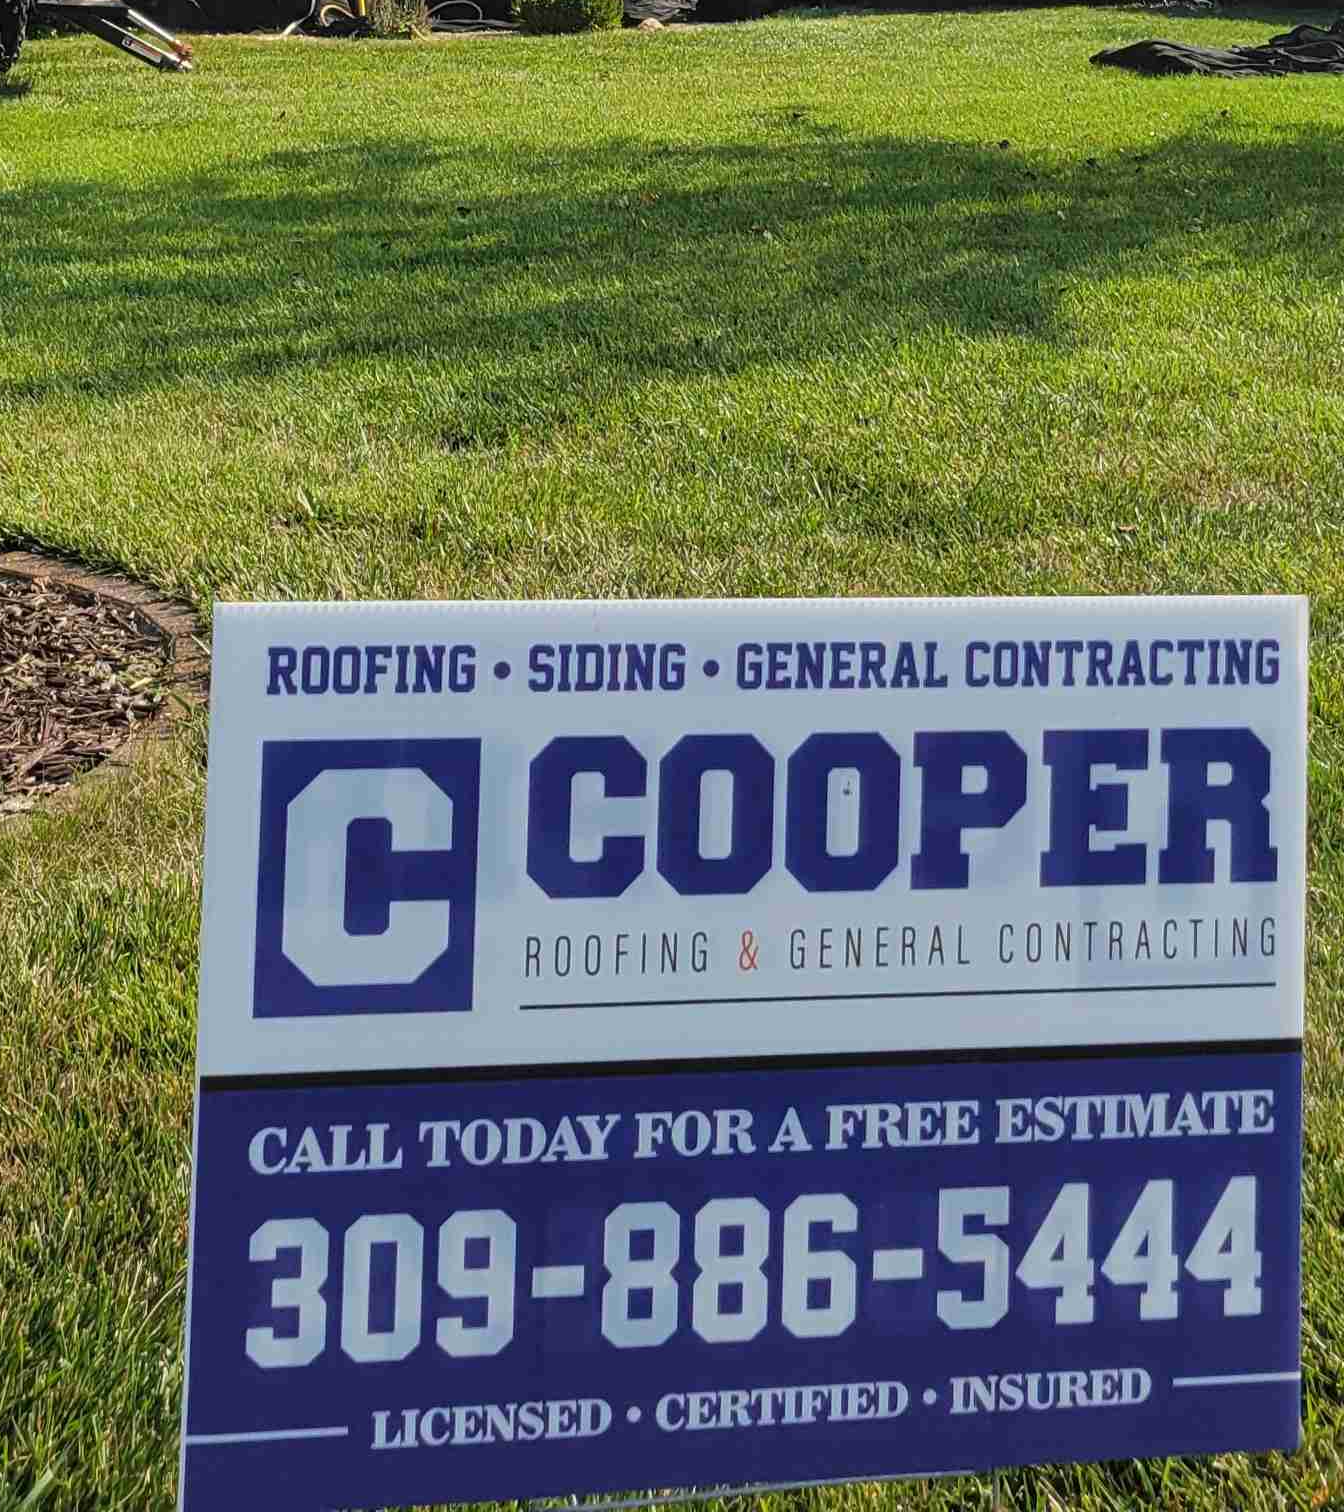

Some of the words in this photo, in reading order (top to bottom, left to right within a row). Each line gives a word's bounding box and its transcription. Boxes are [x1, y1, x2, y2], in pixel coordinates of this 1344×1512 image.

[267, 644, 476, 695] ROOFING
[527, 643, 686, 693] SIDING
[736, 641, 949, 691] GENERAL
[965, 639, 1280, 688] CONTRACTING
[525, 727, 1279, 900] COOPER
[523, 931, 711, 979] ROOFING
[738, 930, 760, 973] &
[788, 924, 972, 970] GENERAL
[997, 917, 1278, 964] CONTRACTING
[248, 1123, 403, 1175] CALL
[419, 1114, 621, 1167] TODAY
[633, 1109, 757, 1158] FOR
[767, 1107, 813, 1152] A
[825, 1100, 980, 1150] FREE
[995, 1089, 1275, 1143] ESTIMATE
[245, 1175, 1263, 1368] 309-886-5444
[371, 1399, 612, 1450] LICENSED
[655, 1381, 910, 1431] CERTIFIED
[950, 1367, 1152, 1416] INSURED
